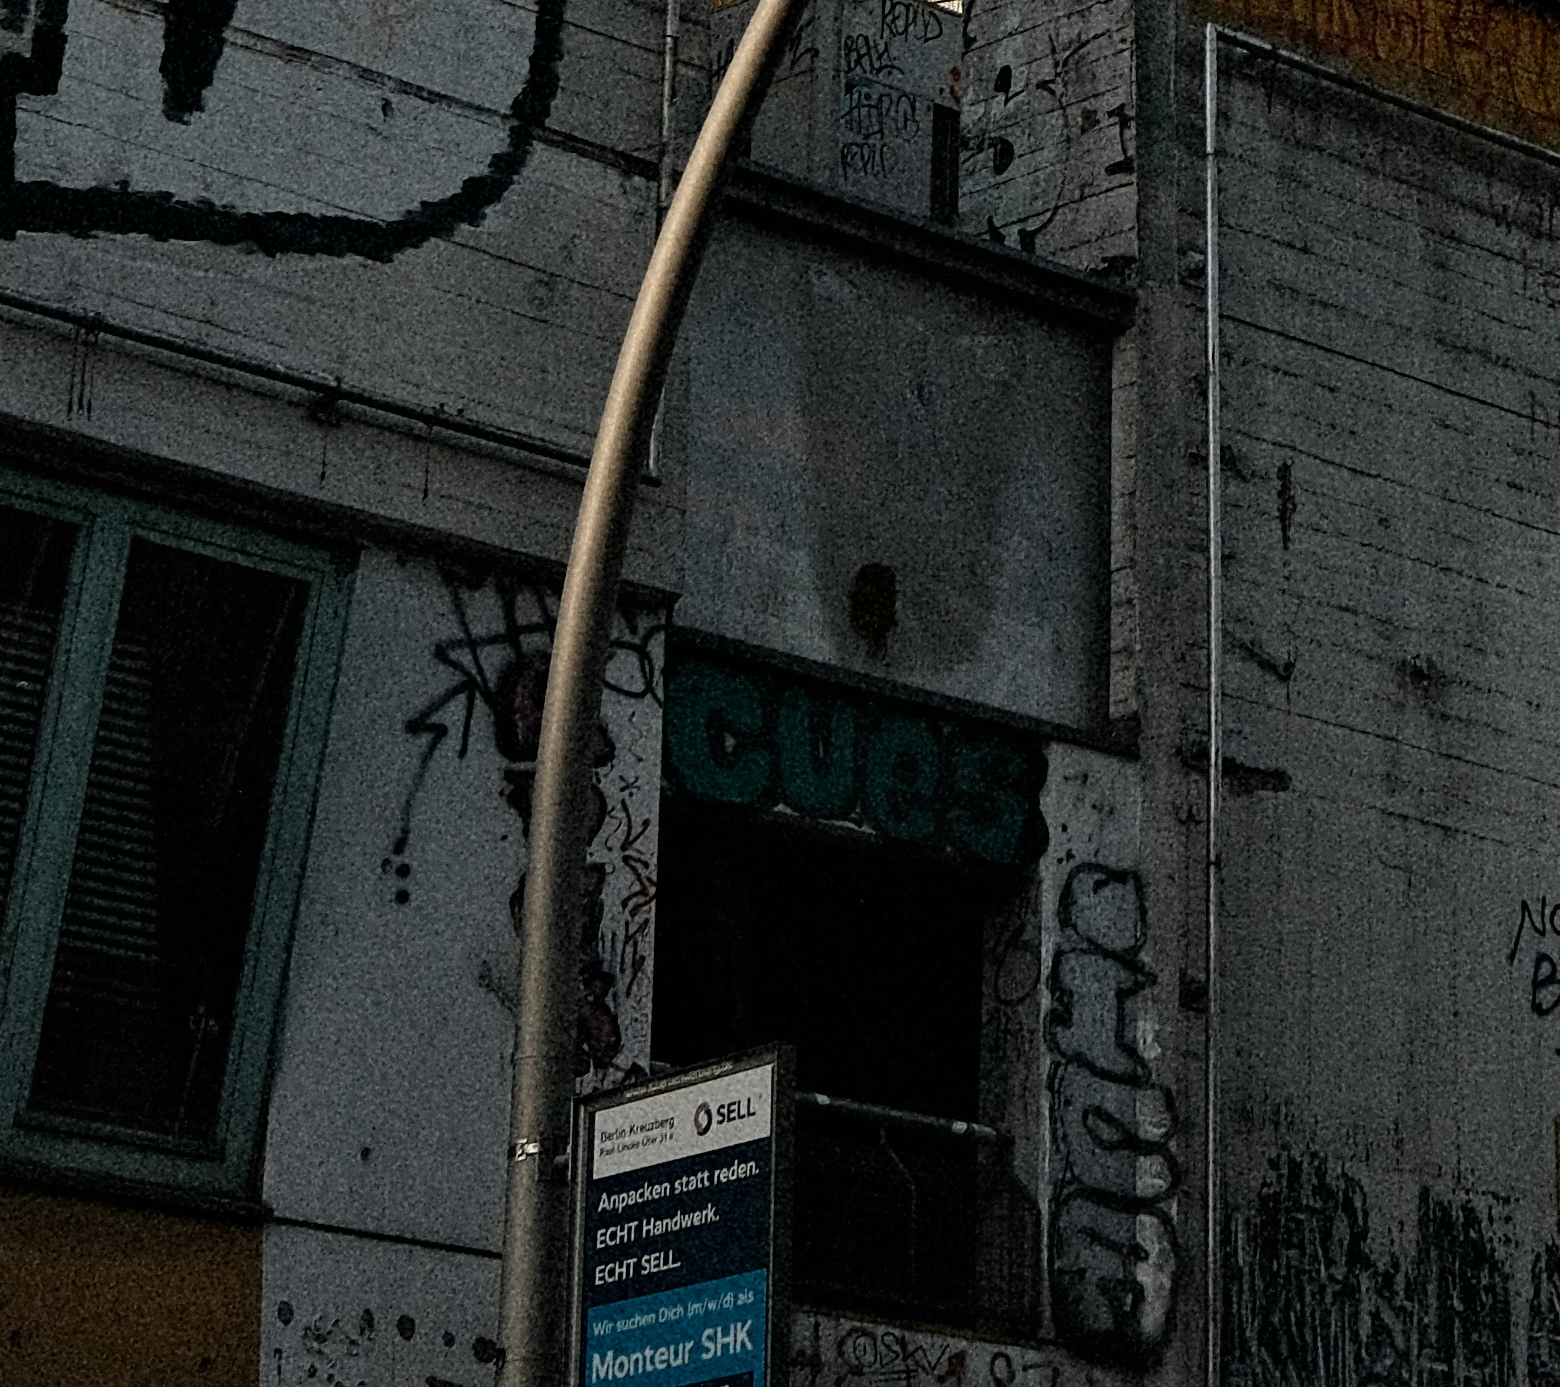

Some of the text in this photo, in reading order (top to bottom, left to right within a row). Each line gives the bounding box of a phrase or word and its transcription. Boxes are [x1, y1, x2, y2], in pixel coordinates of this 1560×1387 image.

[716, 1097, 756, 1126] SELL
[597, 1158, 760, 1215] Anpacken statt reden.
[596, 1203, 720, 1250] ECHT Handwerk.
[594, 1258, 638, 1286] ECHT
[592, 1321, 614, 1337] Wir
[616, 1313, 657, 1332] suchen
[658, 1305, 684, 1324] Dich
[737, 1288, 755, 1305] als
[591, 1318, 754, 1384] Monteur SHK
